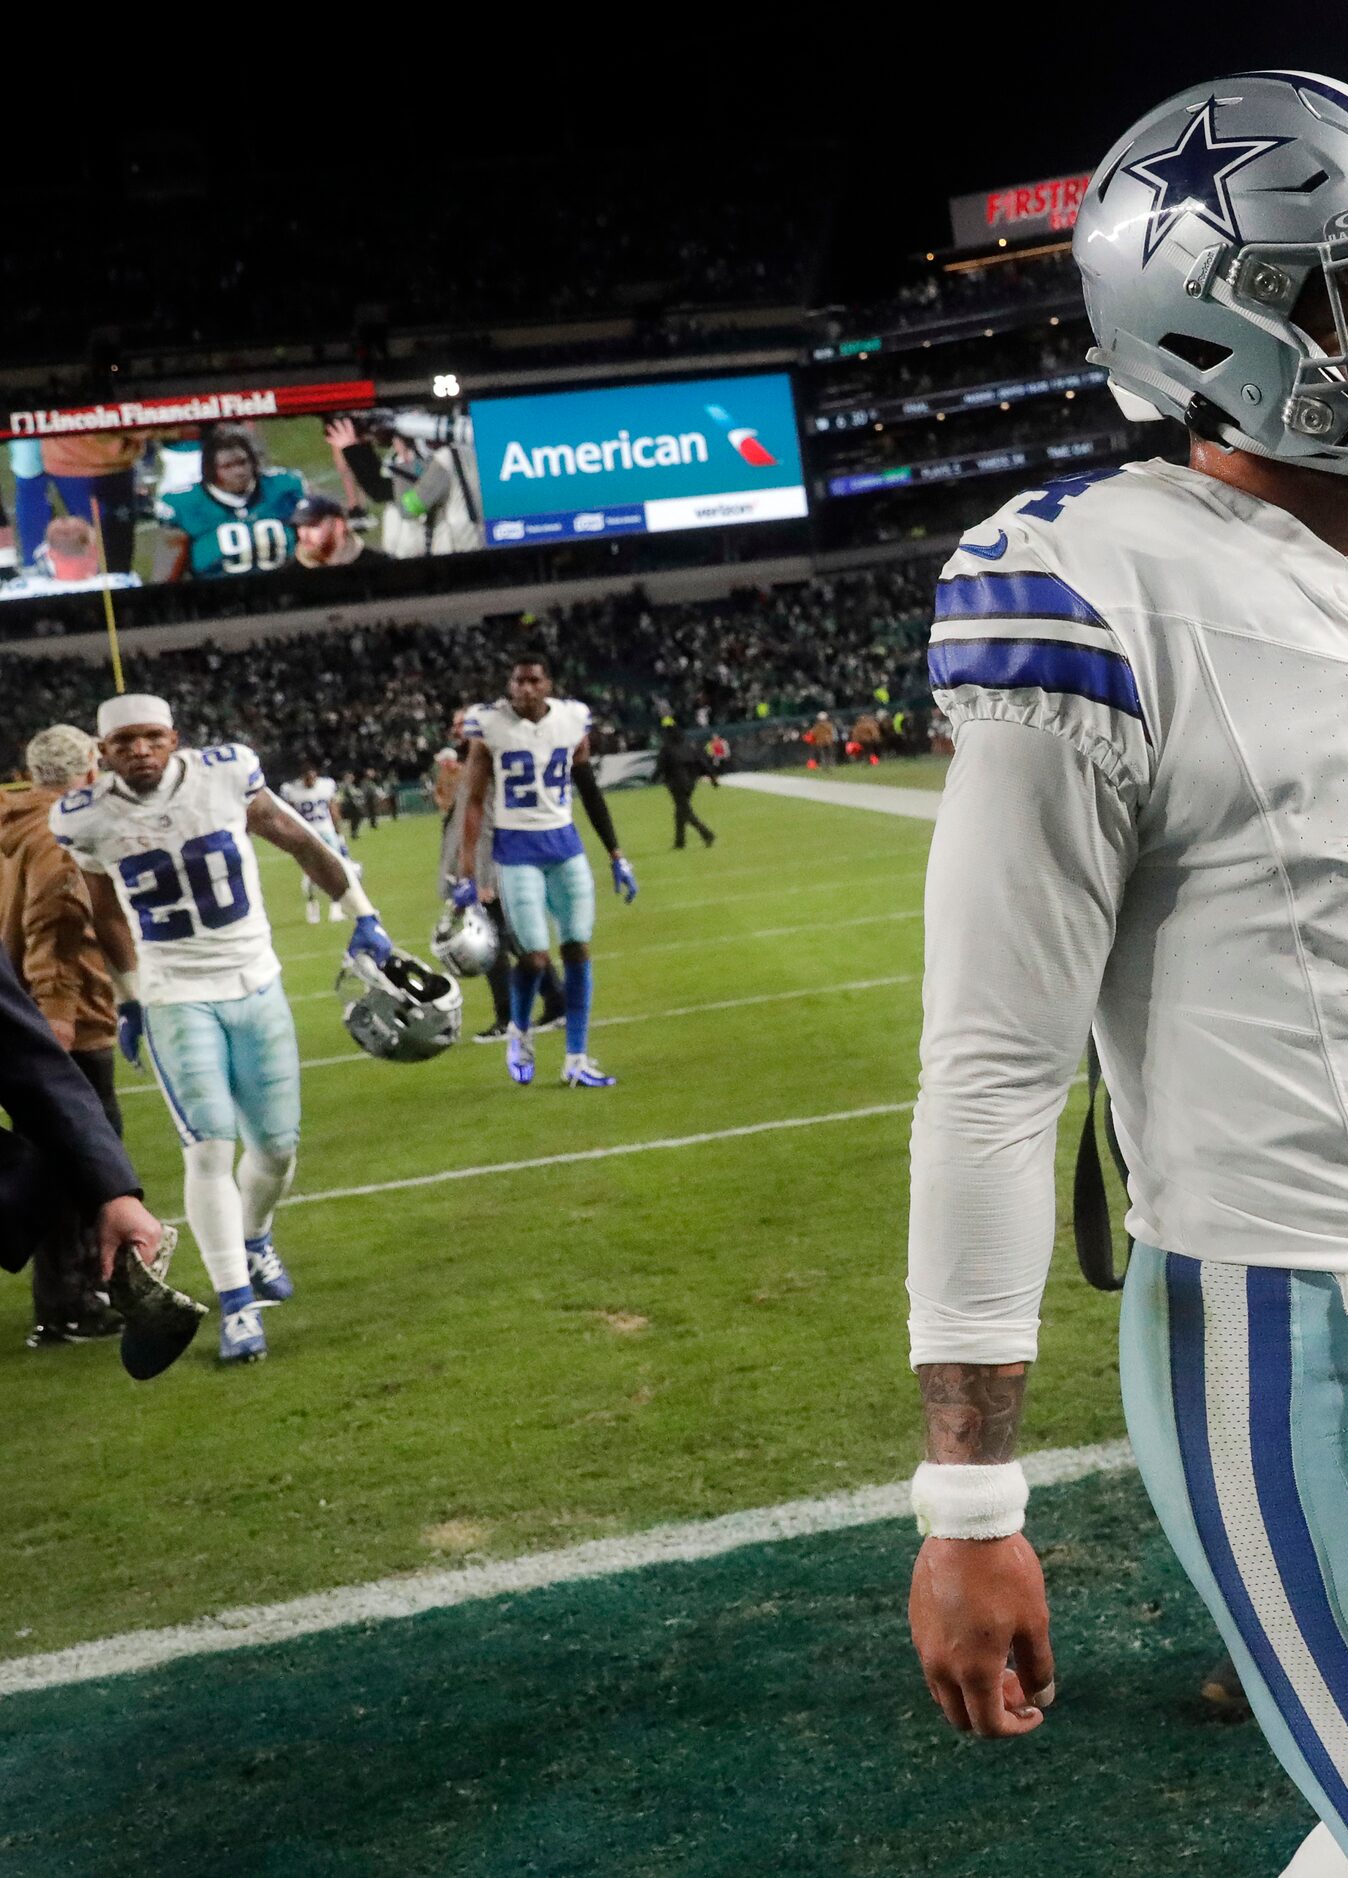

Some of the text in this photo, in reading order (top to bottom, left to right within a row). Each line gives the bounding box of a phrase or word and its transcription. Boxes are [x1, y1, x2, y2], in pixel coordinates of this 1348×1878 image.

[35, 390, 278, 434] Lincoln Financial Field
[499, 429, 709, 482] American
[216, 518, 287, 574] 90
[501, 747, 571, 809] 24
[118, 829, 250, 942] 20
